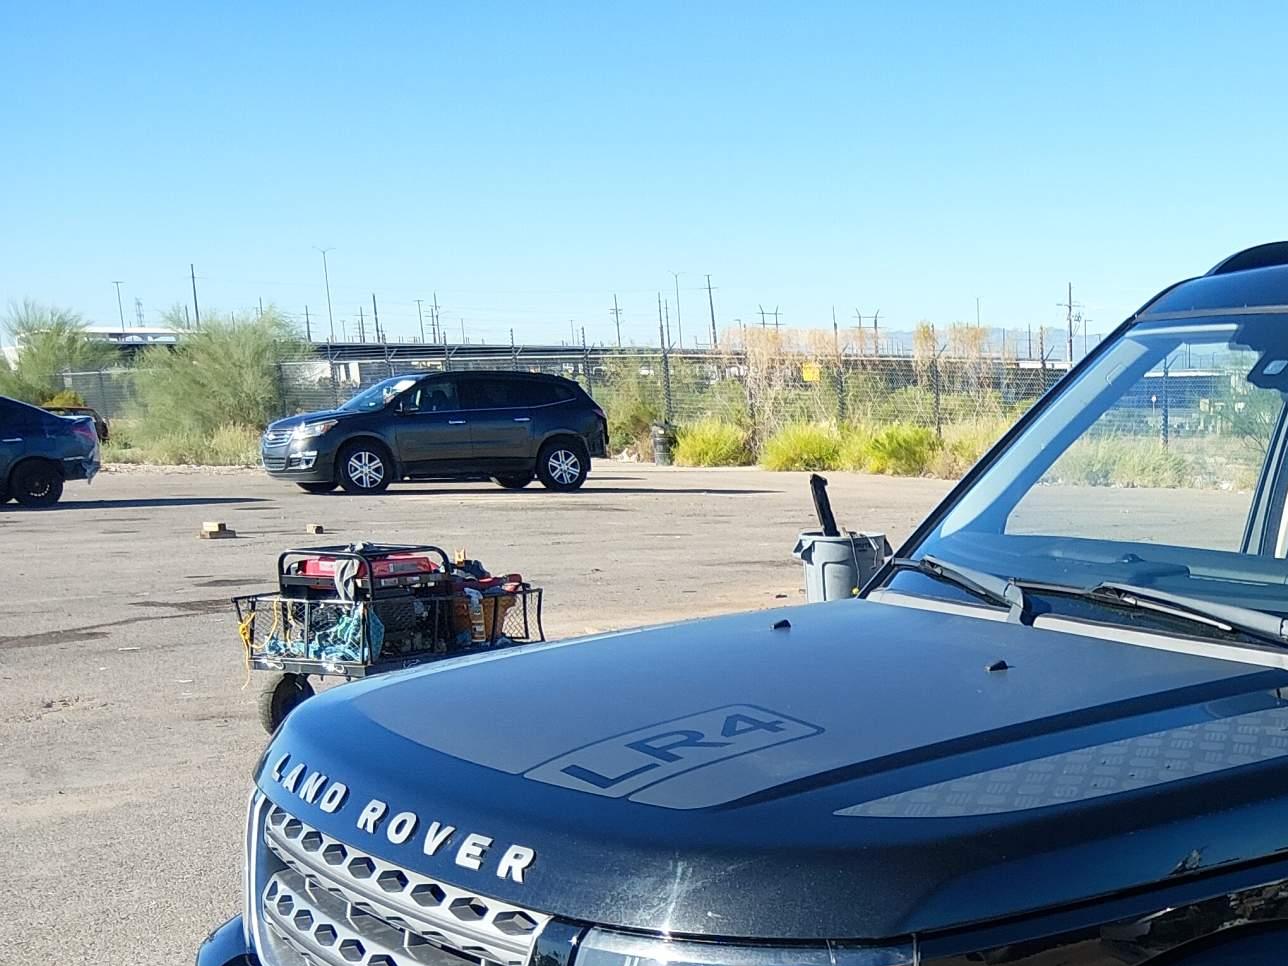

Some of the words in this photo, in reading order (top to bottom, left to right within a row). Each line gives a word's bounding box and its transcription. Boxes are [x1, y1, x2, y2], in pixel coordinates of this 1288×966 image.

[559, 713, 788, 789] LR4
[271, 752, 350, 814] LAND
[356, 799, 537, 884] ROVER
